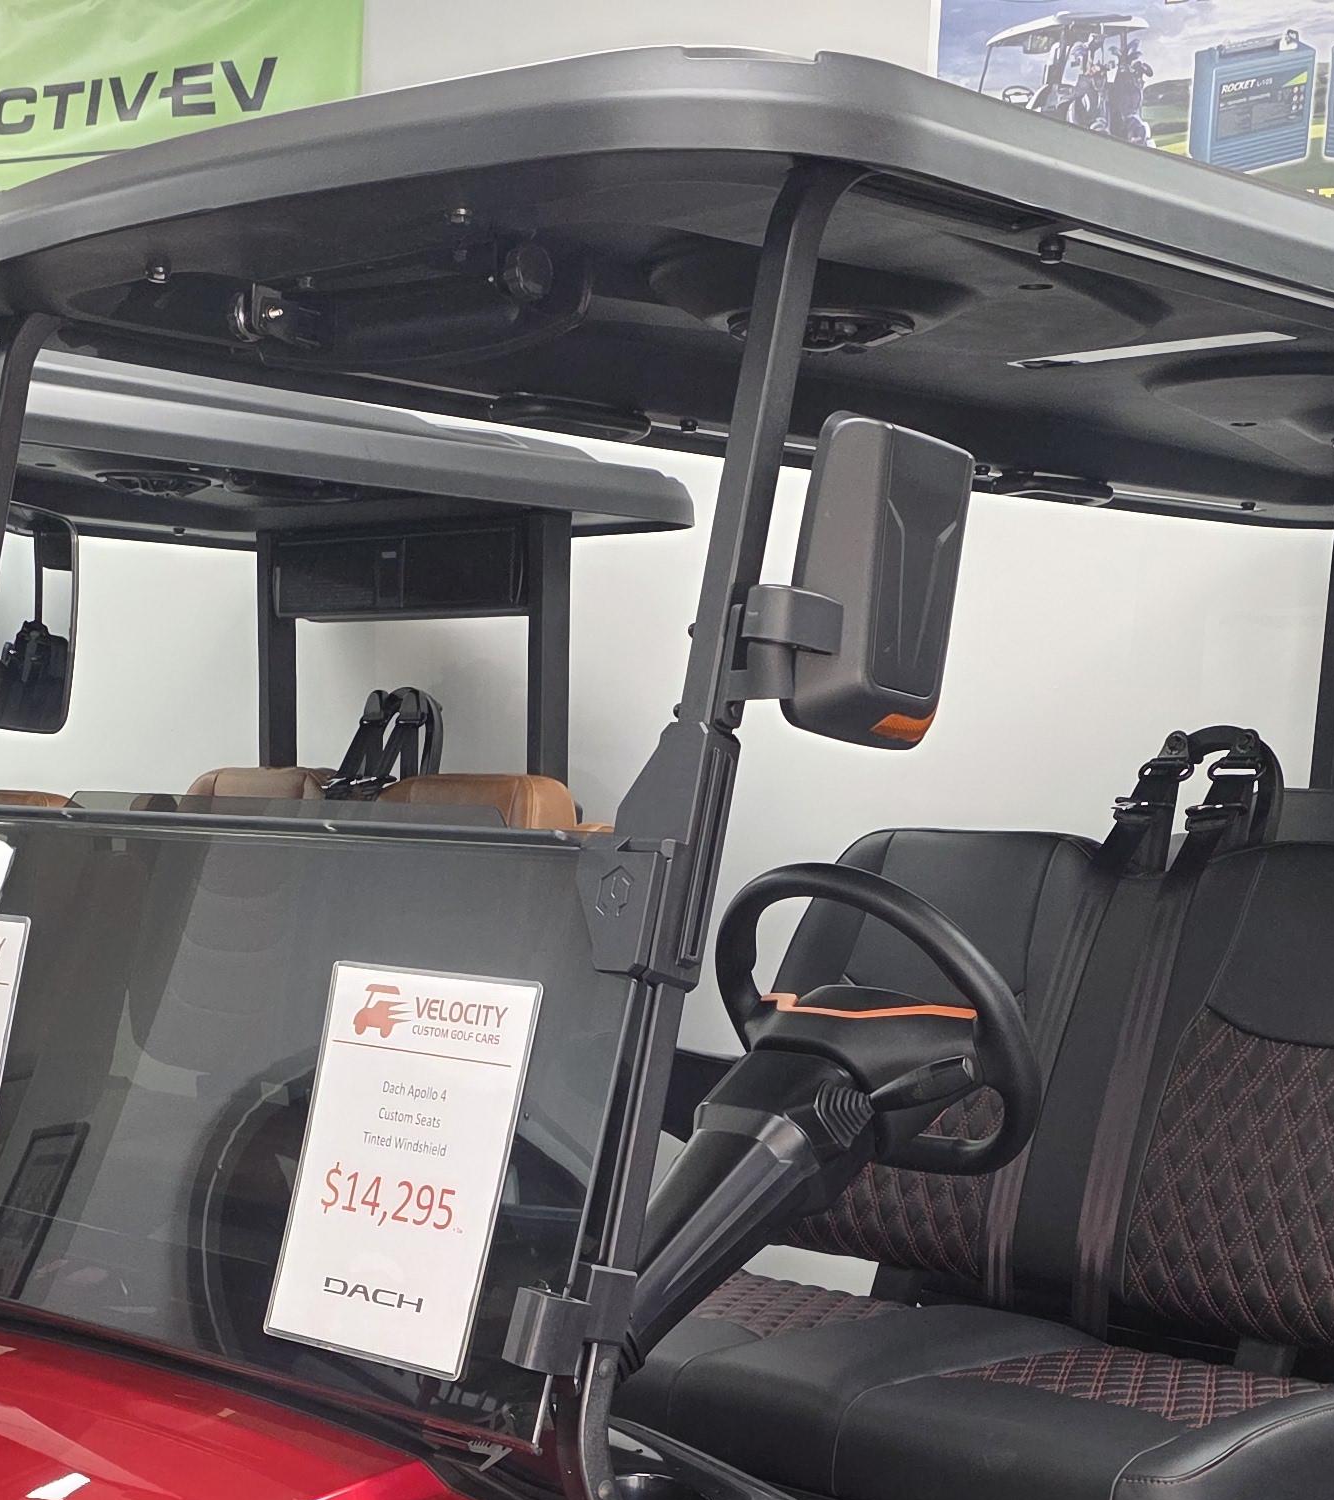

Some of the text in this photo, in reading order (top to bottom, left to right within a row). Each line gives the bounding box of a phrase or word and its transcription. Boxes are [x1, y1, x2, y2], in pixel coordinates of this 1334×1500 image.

[1221, 79, 1256, 95] ROCKET
[415, 996, 509, 1029] VELOCITY
[411, 1024, 501, 1046] CUSTOM GOLF CARS
[382, 1080, 448, 1102] Dach Apollo 4
[378, 1107, 442, 1129] Custom Seats
[363, 1130, 448, 1158] Tinted Windshield
[320, 1161, 456, 1231] $14,295
[323, 1276, 424, 1314] DACH
